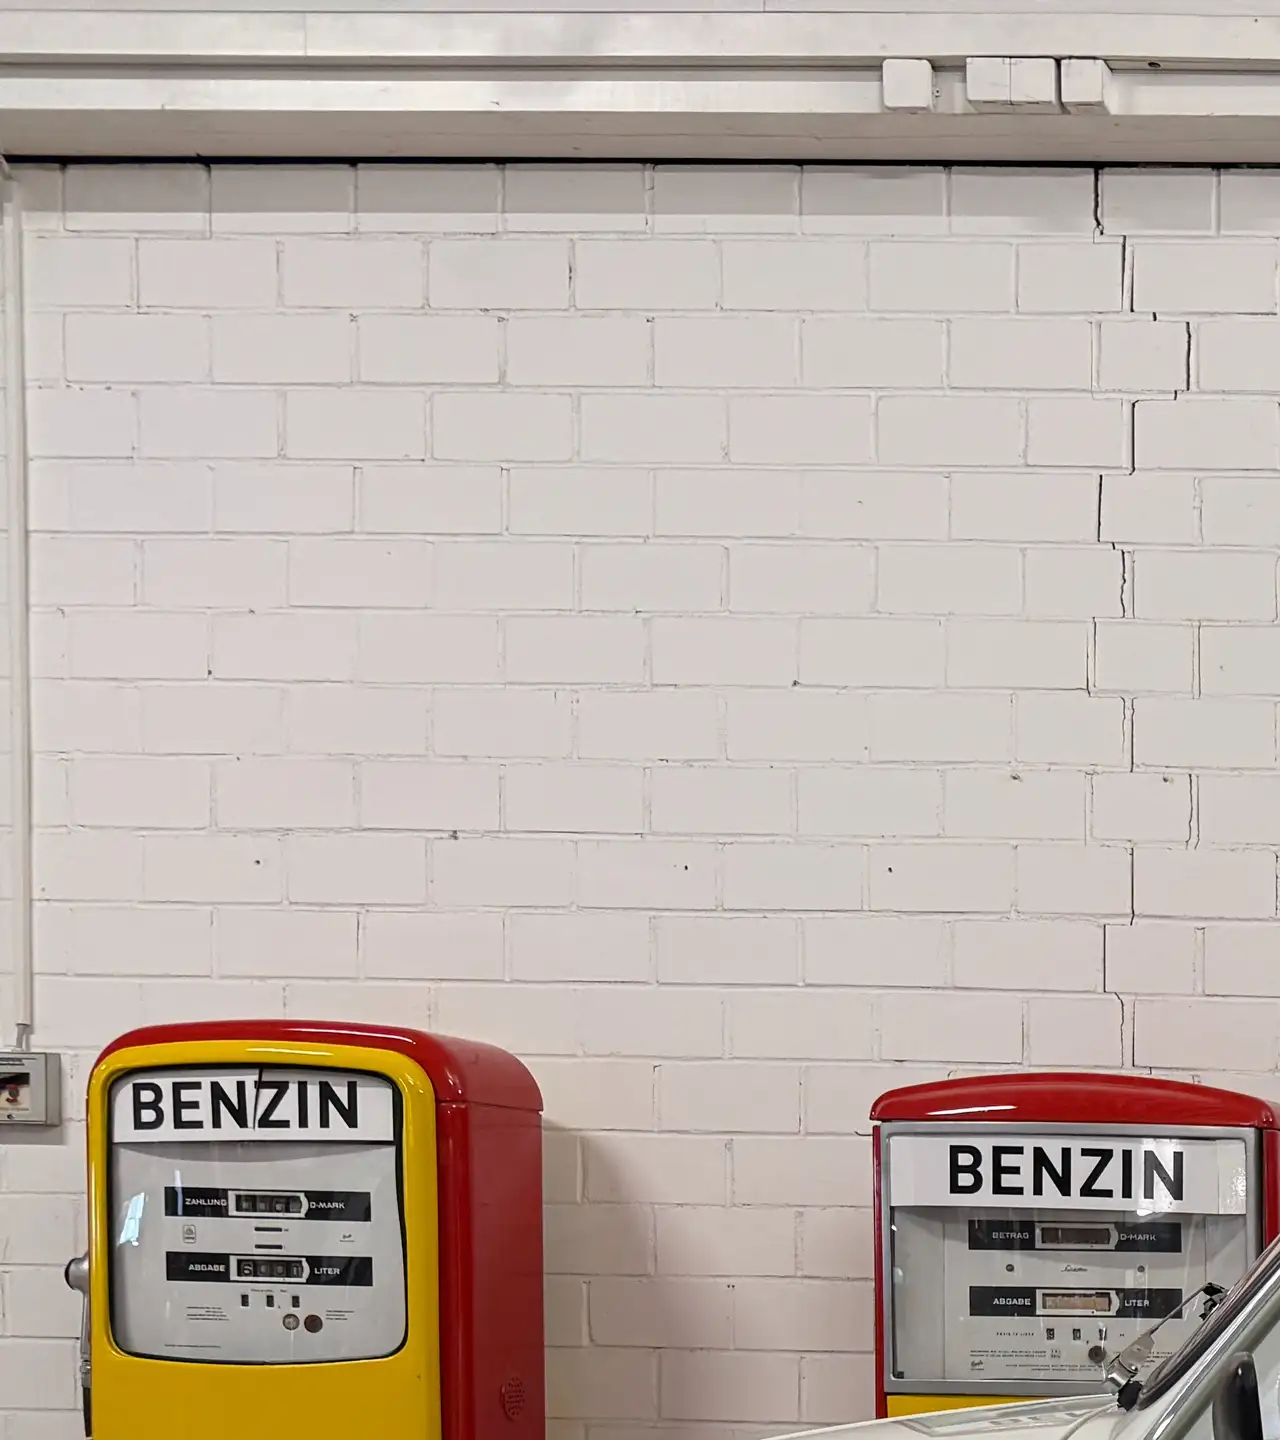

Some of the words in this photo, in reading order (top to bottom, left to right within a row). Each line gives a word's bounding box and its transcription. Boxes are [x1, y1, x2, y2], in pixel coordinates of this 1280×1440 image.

[132, 1081, 359, 1130] BENZIN
[949, 1145, 1185, 1201] BENZIN
[310, 1201, 345, 1209] D-MARK
[1120, 1233, 1156, 1241] D-MARK
[314, 1267, 340, 1275] LITER
[1124, 1299, 1150, 1307] LITER
